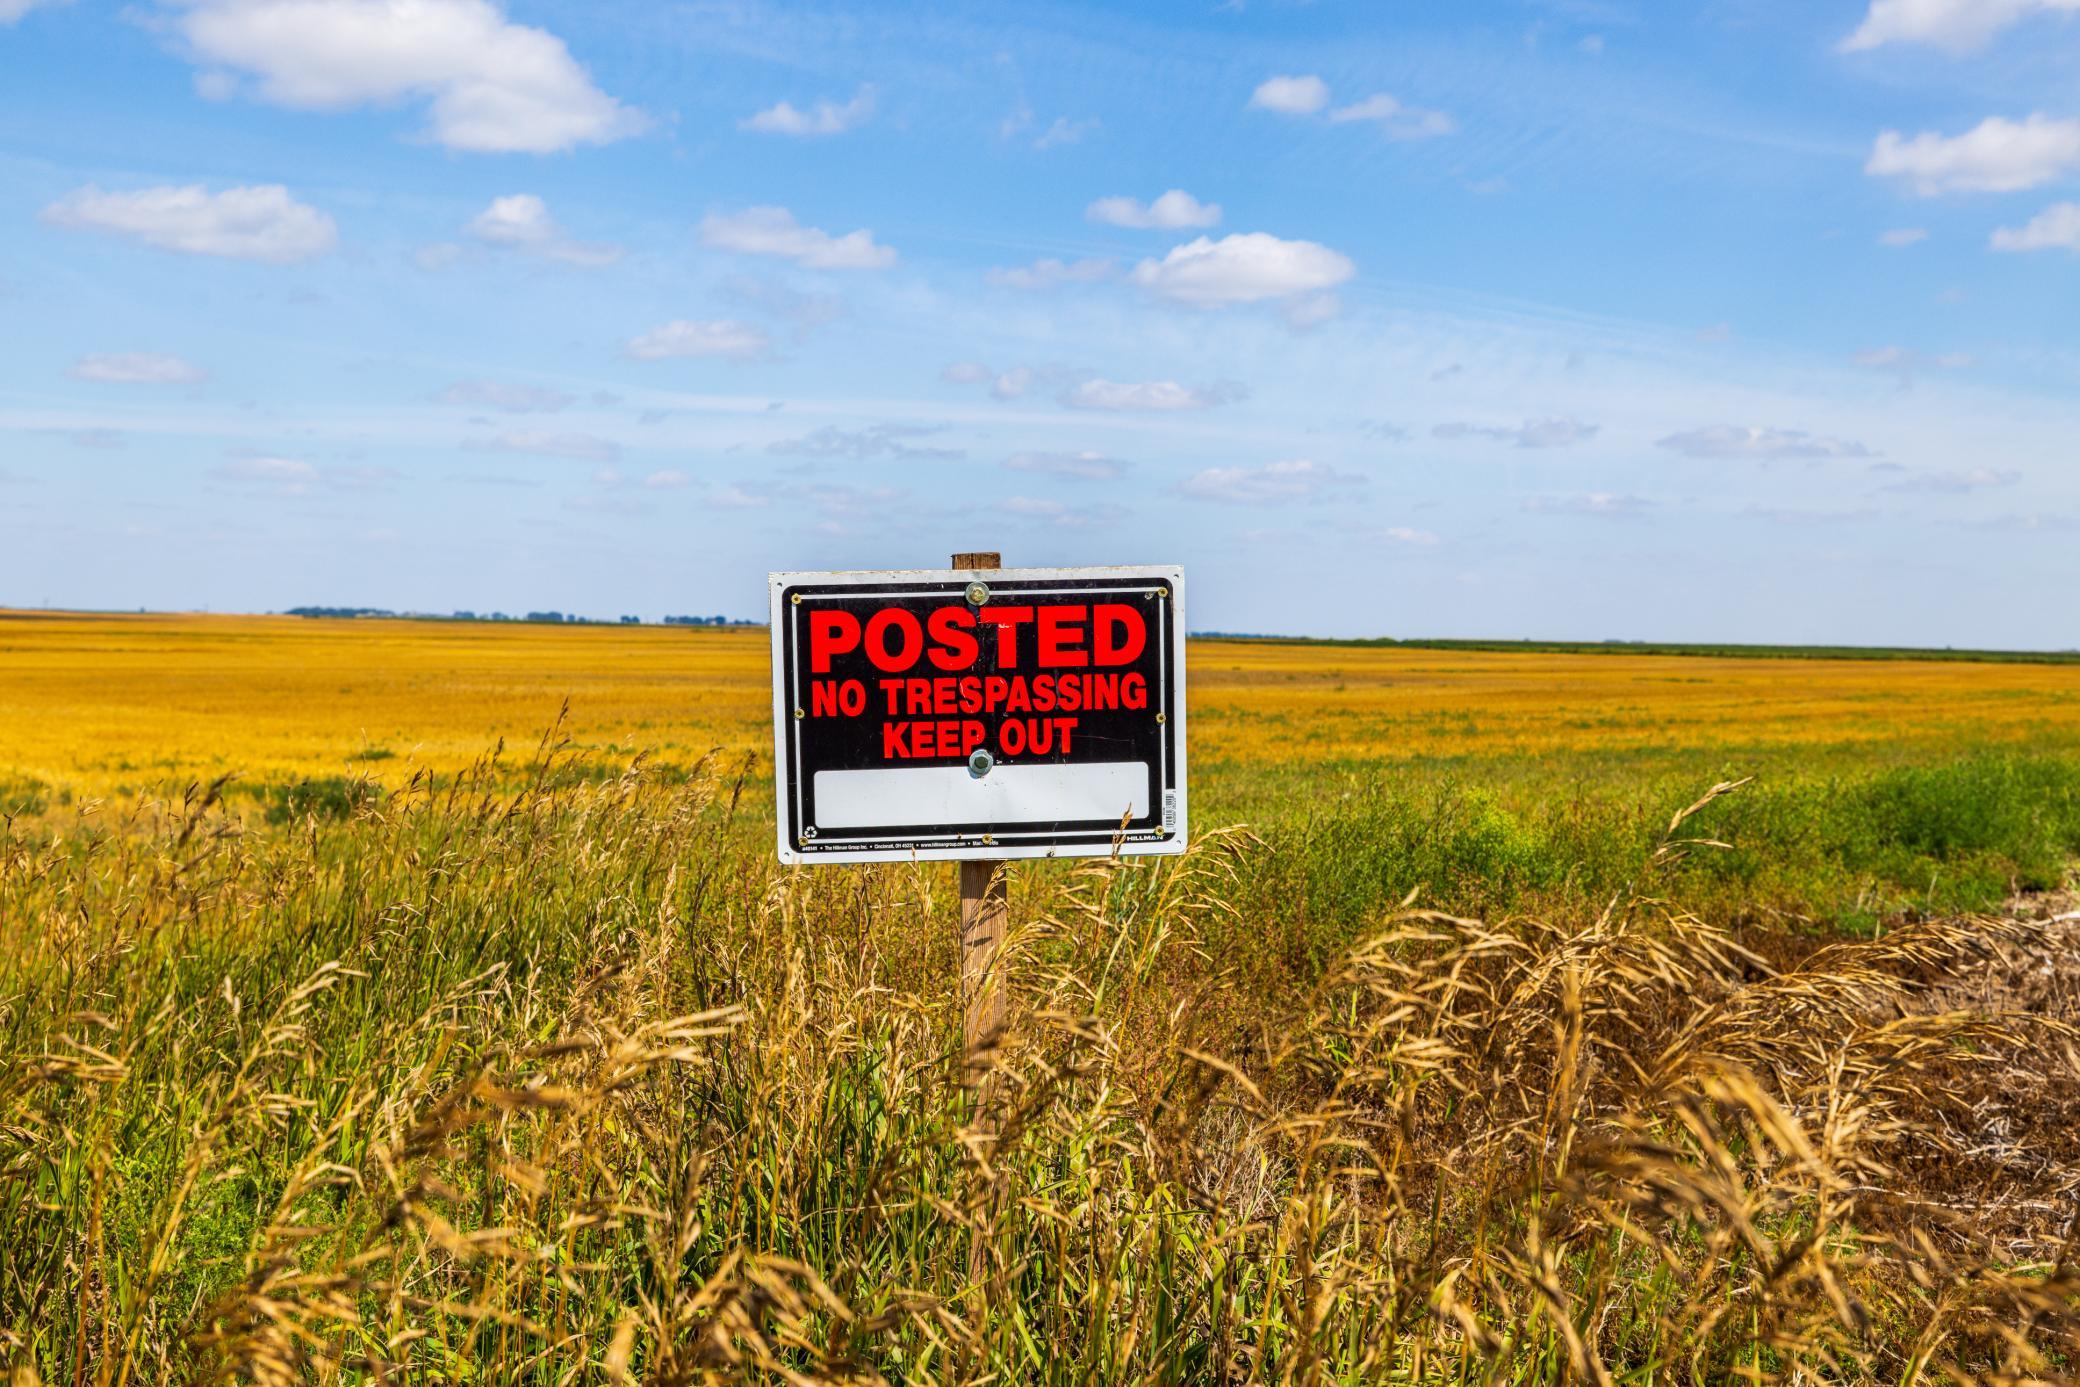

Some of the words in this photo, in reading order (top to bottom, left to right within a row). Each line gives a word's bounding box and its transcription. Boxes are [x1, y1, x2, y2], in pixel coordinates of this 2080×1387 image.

[811, 604, 1146, 672] POSTED
[811, 681, 867, 718] NO
[880, 672, 1147, 716] TRESPASSING
[884, 720, 985, 758] KEEP
[1000, 718, 1078, 755] OUT
